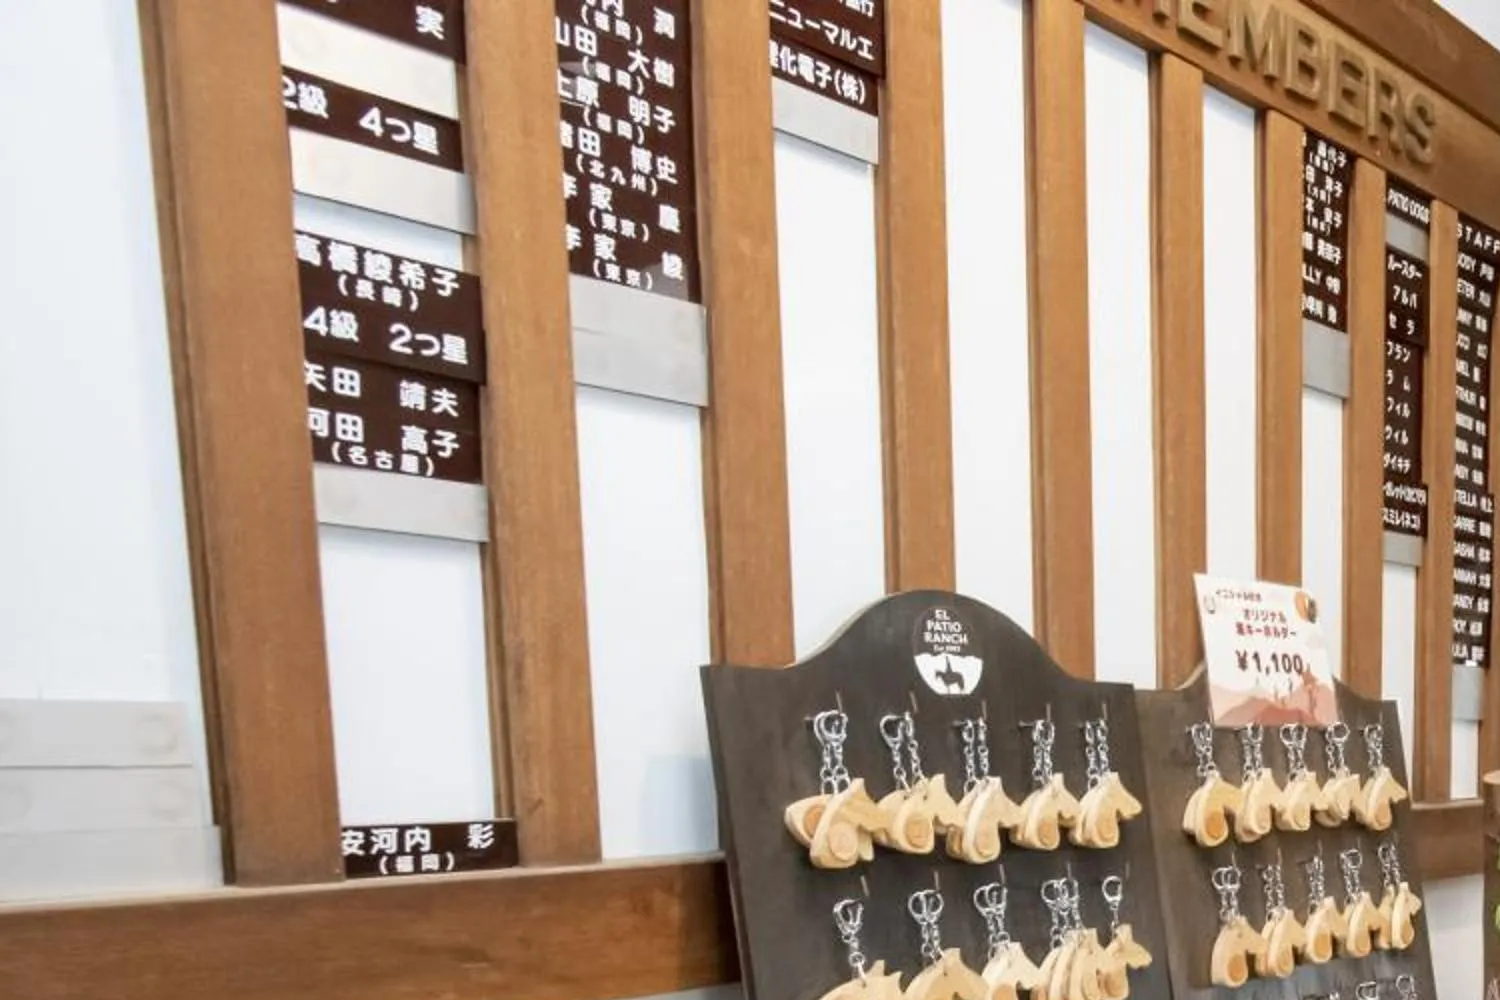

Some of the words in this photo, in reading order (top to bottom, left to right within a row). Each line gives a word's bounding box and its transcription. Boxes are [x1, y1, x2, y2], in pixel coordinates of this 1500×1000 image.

[1118, 0, 1437, 168] EMBERS
[389, 323, 469, 365] 2つ星
[1235, 650, 1304, 676] ¥1,100
